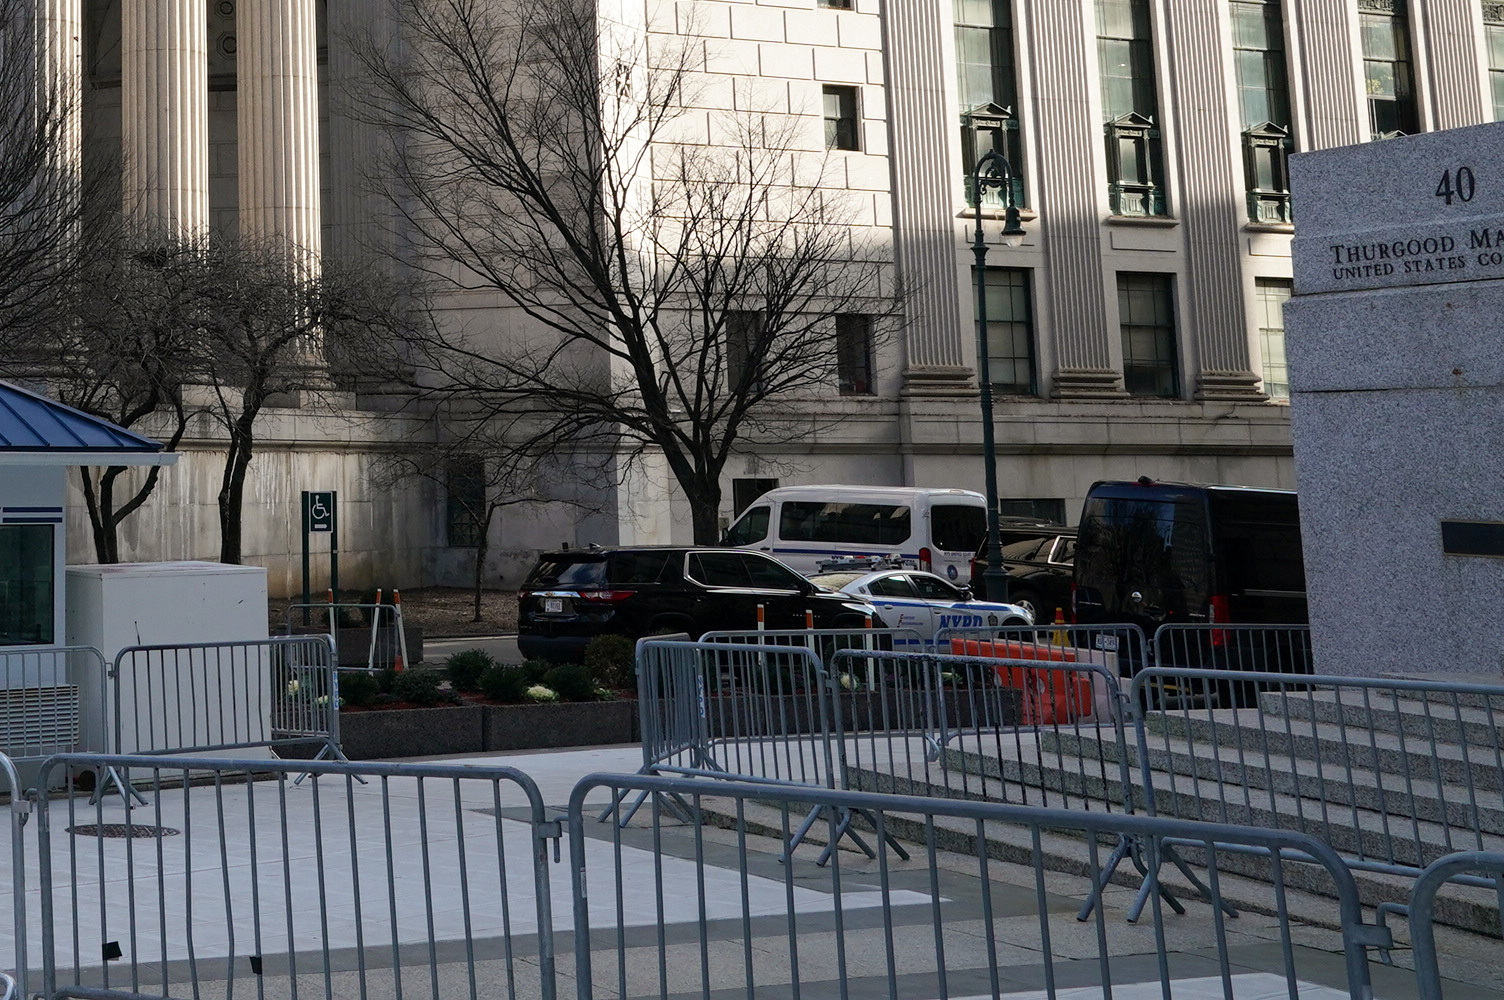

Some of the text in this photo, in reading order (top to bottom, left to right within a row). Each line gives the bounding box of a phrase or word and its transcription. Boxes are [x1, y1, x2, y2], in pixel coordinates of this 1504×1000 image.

[1435, 166, 1475, 205] 40
[1330, 236, 1455, 264] THURGOOD
[1333, 252, 1503, 280] UNITED STATES CO
[939, 615, 983, 628] NYPD
